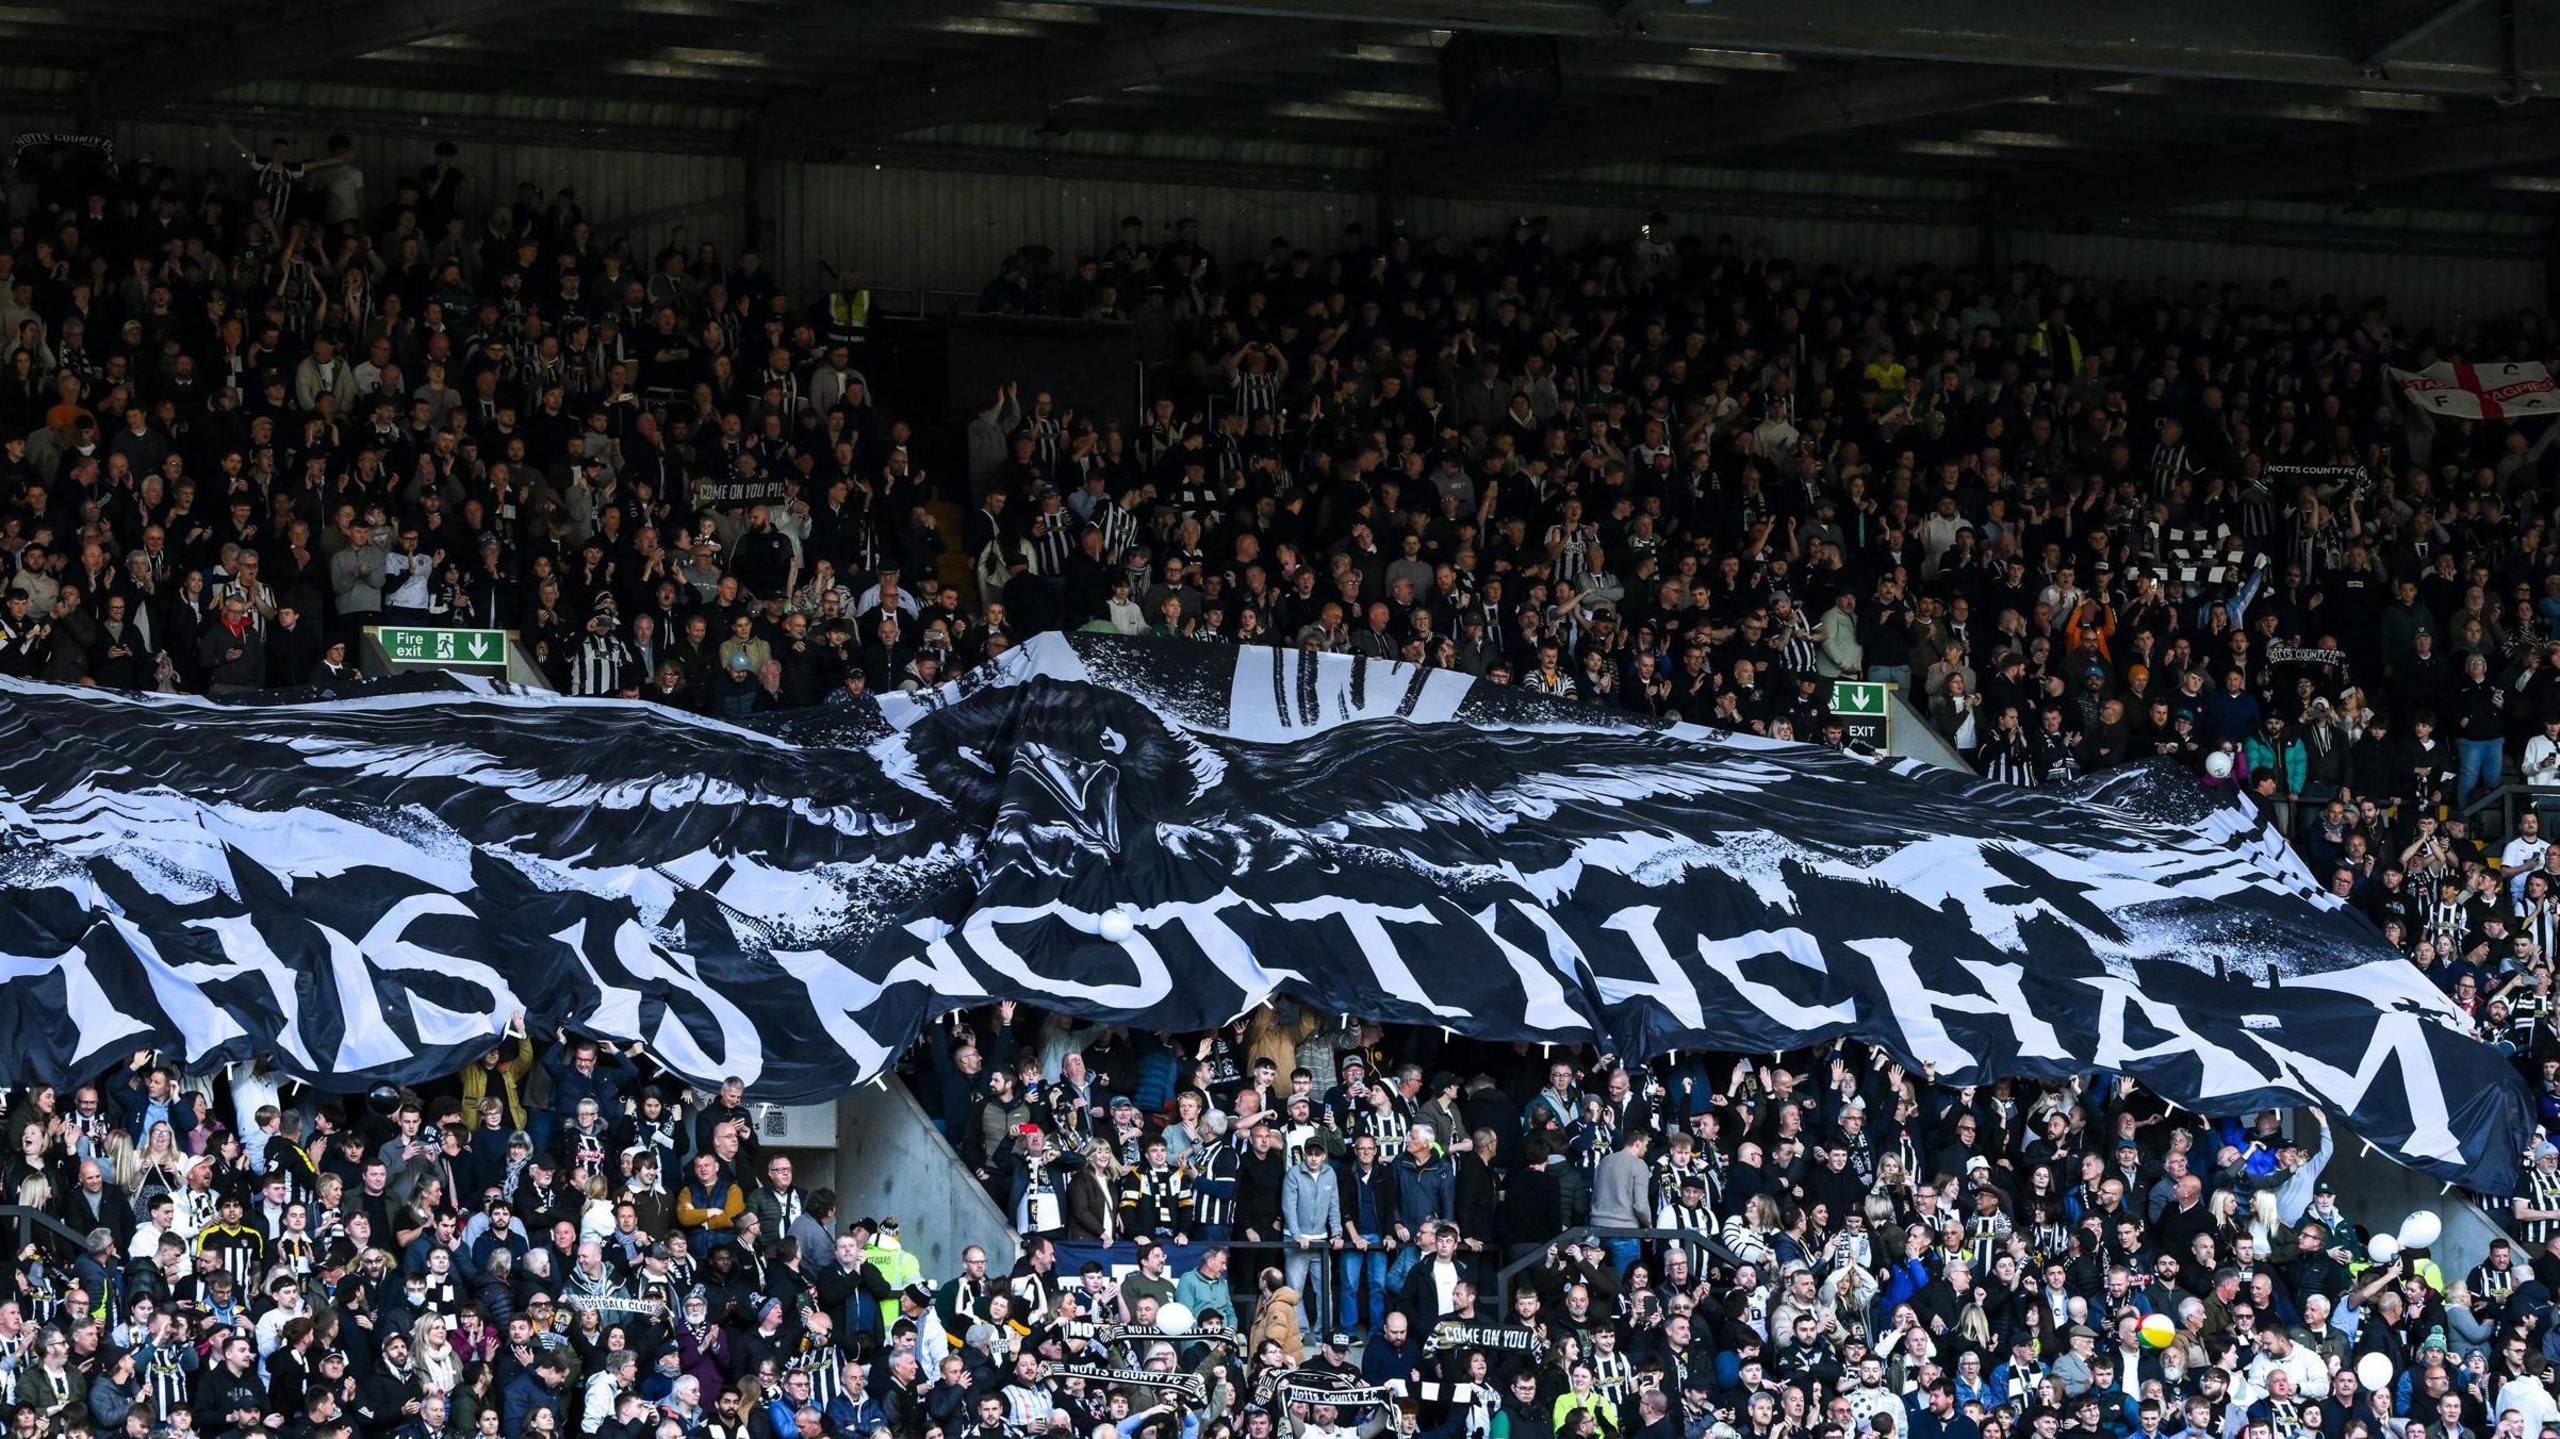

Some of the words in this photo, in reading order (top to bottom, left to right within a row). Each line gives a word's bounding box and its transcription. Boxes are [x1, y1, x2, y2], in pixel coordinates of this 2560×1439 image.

[16, 132, 49, 146] NOTTS
[54, 133, 102, 145] COUNTY
[2268, 465, 2301, 475] NOTTS
[2302, 465, 2342, 475] COUNTY
[2343, 467, 2356, 476] FC
[700, 484, 728, 500] COME
[729, 484, 745, 500] ON
[746, 482, 765, 498] YOU
[767, 481, 785, 498] PIE
[397, 632, 424, 645] Fire
[397, 645, 422, 657] exit
[2271, 650, 2293, 660] OTTS
[2295, 650, 2328, 660] COUNTY
[1849, 725, 1876, 737] EXIT
[550, 917, 763, 1086] IS
[868, 1256, 891, 1265] TEWARD
[580, 1299, 626, 1309] FOOTBALL
[628, 1301, 653, 1312] CLUB
[1444, 1326, 1480, 1345] COME
[1482, 1328, 1501, 1347] ON
[1503, 1329, 1529, 1349] YOU
[1069, 1364, 1109, 1377] NOTTS
[1112, 1367, 1163, 1382] COUNTY
[1166, 1374, 1183, 1385] FC
[1291, 1388, 1319, 1401] Notts
[1322, 1391, 1358, 1402] County
